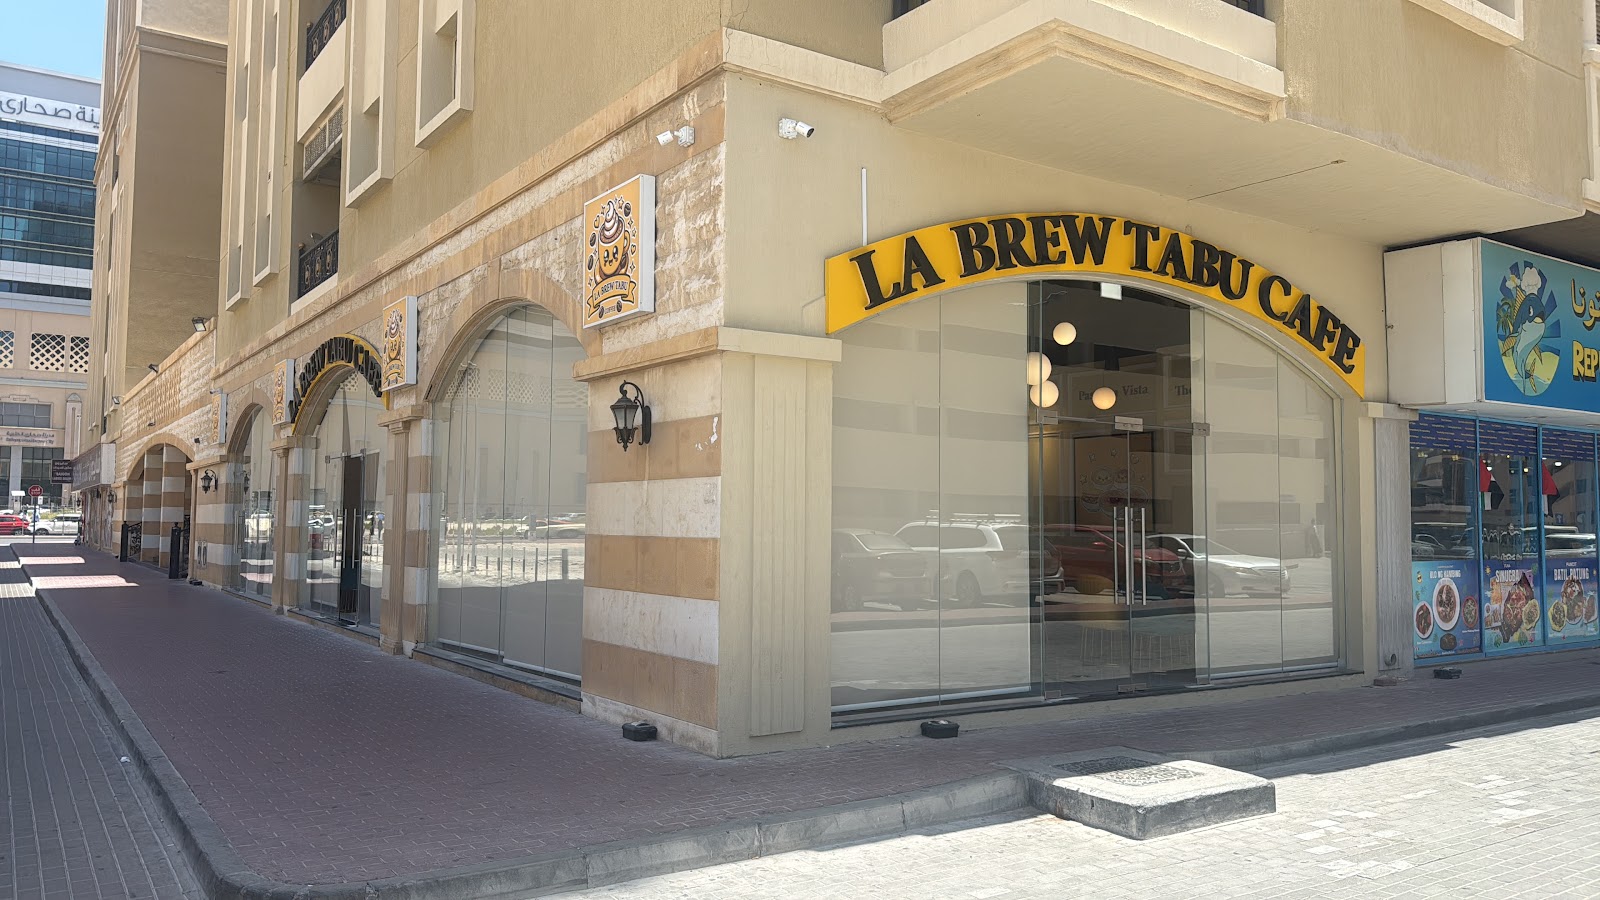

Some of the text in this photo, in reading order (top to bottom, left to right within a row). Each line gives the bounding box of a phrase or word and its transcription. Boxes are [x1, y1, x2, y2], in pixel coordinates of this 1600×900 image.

[849, 215, 1362, 374] LA BREW TABU CAFE
[1573, 340, 1600, 382] REP
[1122, 385, 1148, 396] Vista
